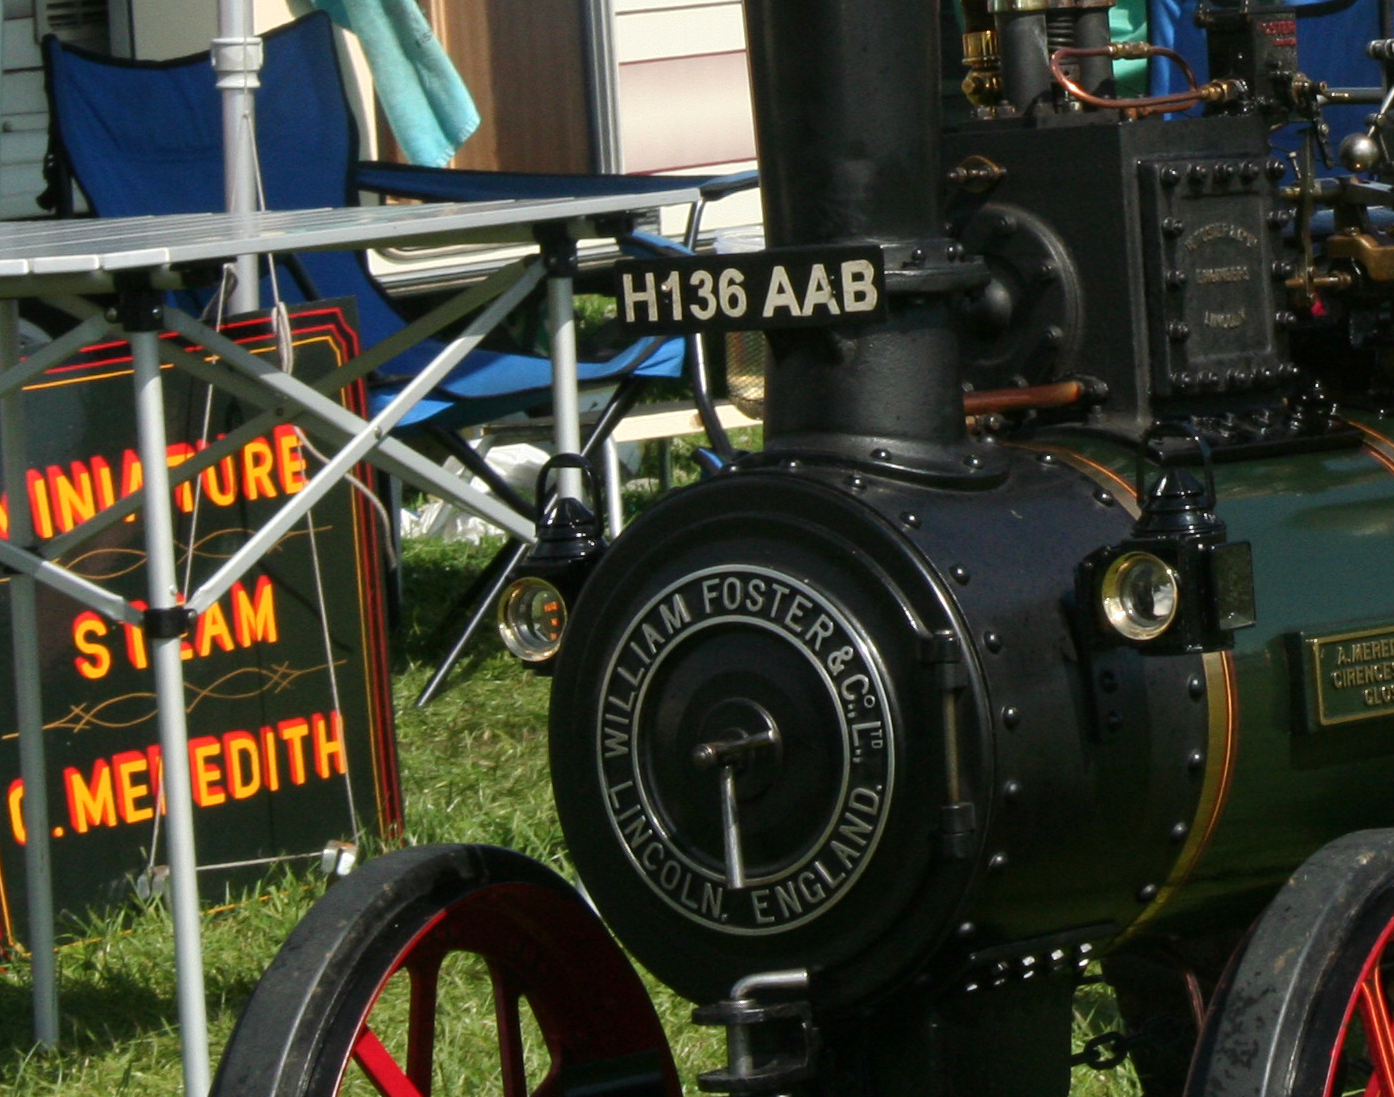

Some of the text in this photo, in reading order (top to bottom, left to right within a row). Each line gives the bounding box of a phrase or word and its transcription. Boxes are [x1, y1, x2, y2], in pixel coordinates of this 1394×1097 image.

[622, 259, 878, 322] H136 AAB
[604, 594, 692, 759] WILLIAM
[702, 576, 834, 651] FOSTER
[827, 646, 854, 676] &
